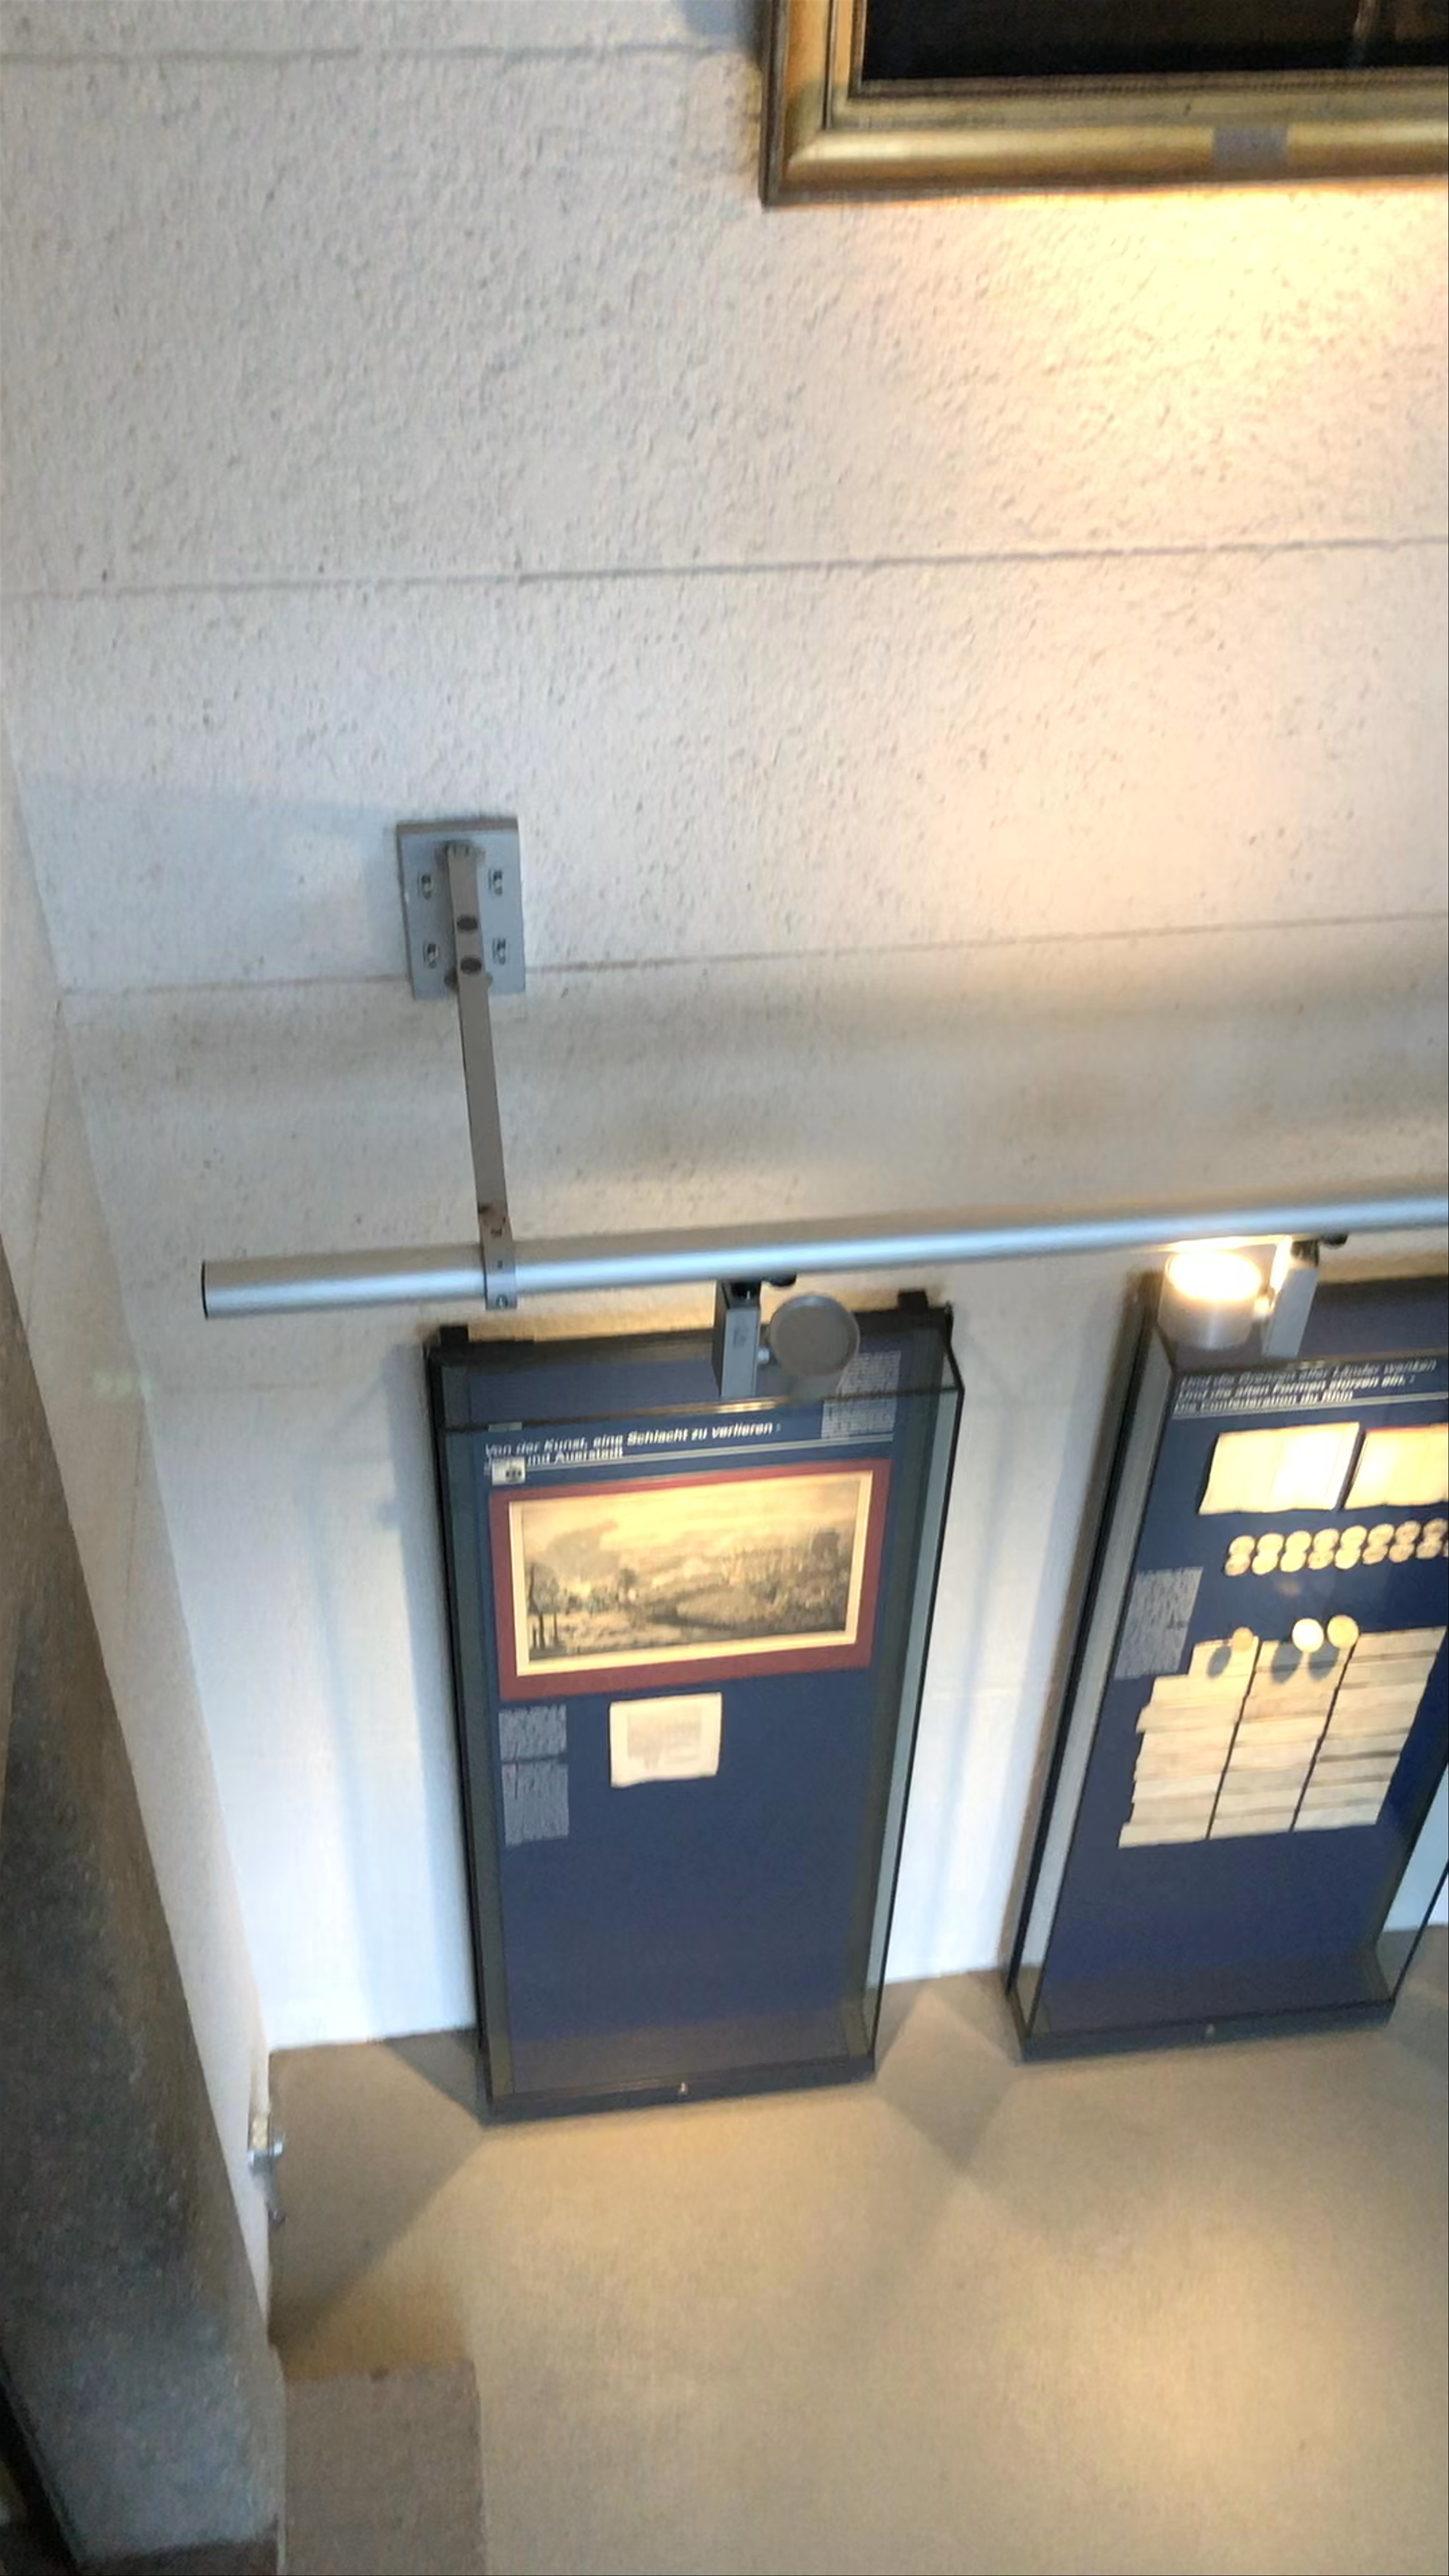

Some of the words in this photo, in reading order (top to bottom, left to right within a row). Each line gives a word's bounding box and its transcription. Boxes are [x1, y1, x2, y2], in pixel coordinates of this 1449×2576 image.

[1234, 1384, 1270, 1397] alten
[1272, 1378, 1326, 1394] Formen
[1299, 1391, 1319, 1404] du
[1321, 1389, 1354, 1404] Rhin
[486, 1442, 512, 1456] Von
[516, 1441, 541, 1455] der
[544, 1437, 588, 1452] Kunst,
[593, 1434, 623, 1448] eine
[627, 1427, 688, 1446] Schlacht
[691, 1427, 708, 1441] zu
[712, 1422, 773, 1439] verlieren
